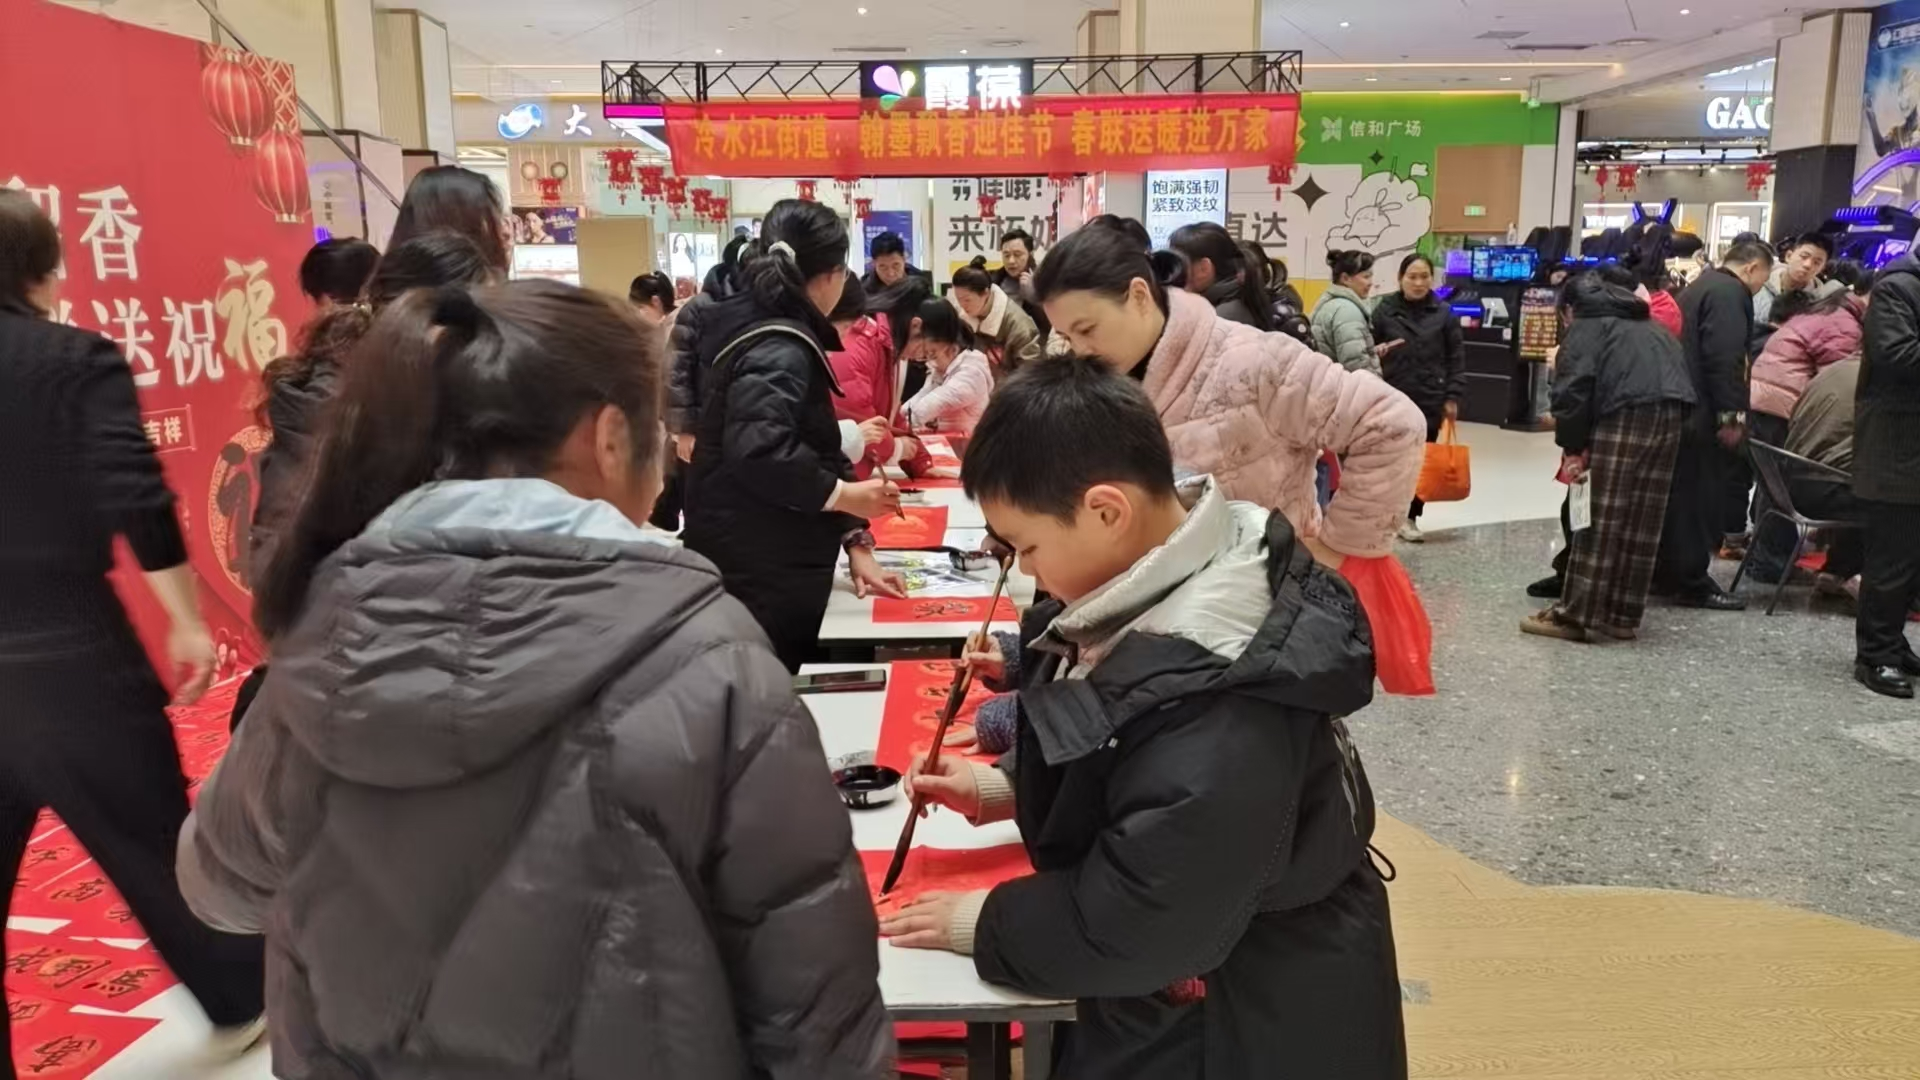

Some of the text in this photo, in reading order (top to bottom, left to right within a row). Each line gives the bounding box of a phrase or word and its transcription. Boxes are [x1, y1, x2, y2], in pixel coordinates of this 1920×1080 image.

[1072, 105, 1271, 157] 春联送暖进万家
[1350, 120, 1421, 137] 信和广场
[1152, 179, 1219, 195] 饱满强韧
[1152, 197, 1219, 212] 紧致淡纹
[48, 257, 288, 387] 送祝福
